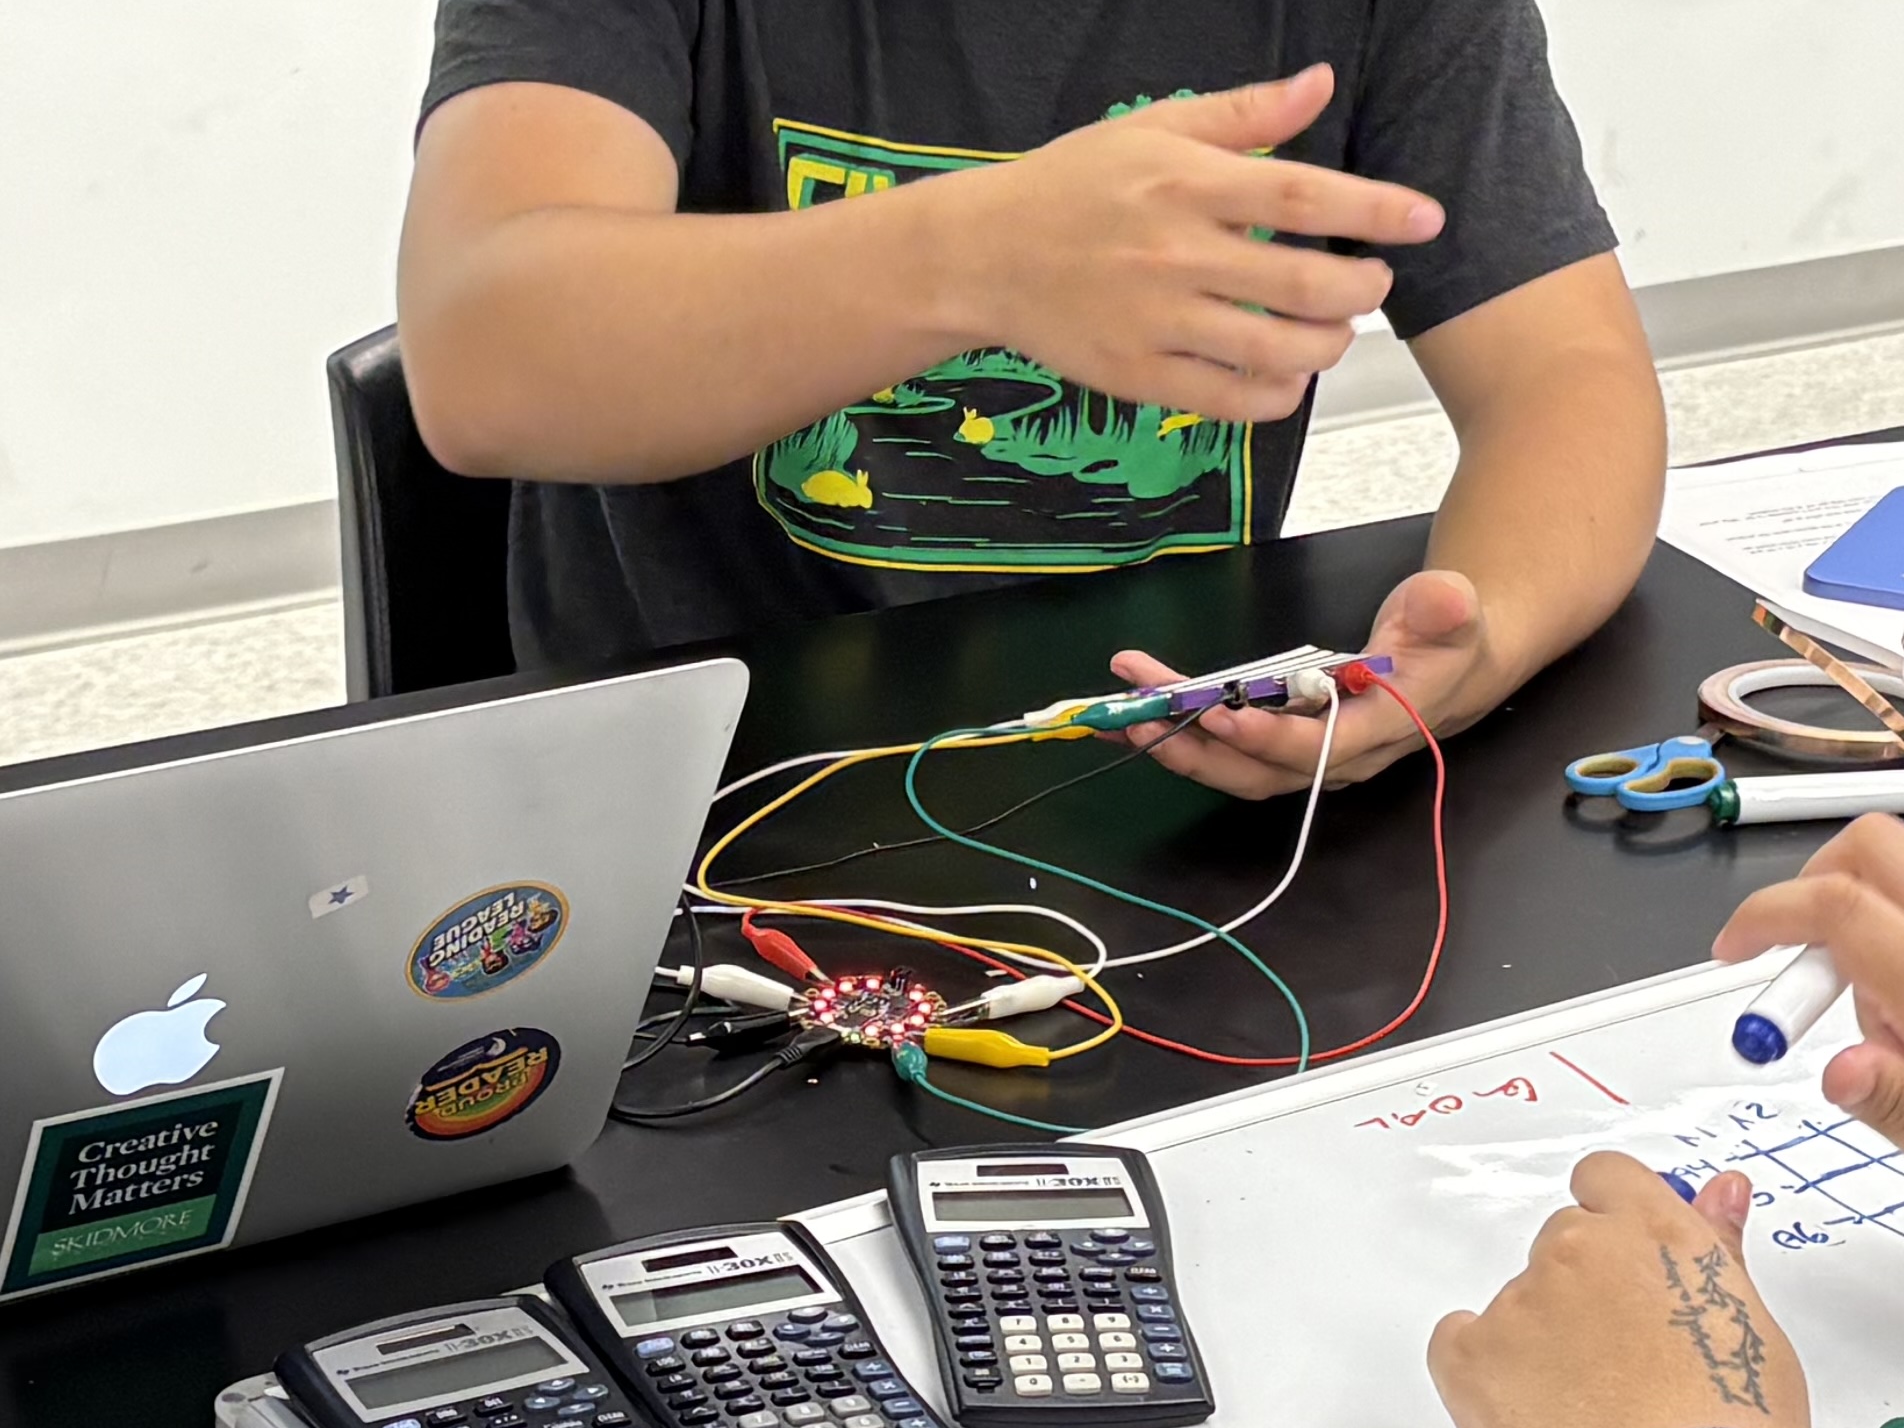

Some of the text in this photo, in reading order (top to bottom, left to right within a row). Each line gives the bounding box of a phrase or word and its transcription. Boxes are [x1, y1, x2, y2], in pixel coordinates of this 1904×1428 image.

[428, 899, 525, 968] READING
[433, 891, 516, 952] LEAGUE
[415, 1046, 549, 1116] READER
[78, 1121, 219, 1163] Creative
[70, 1144, 215, 1190] Thought
[69, 1171, 204, 1215] Matters
[52, 1210, 193, 1256] SKIDMORE
[597, 1411, 625, 1423] CLEAR
